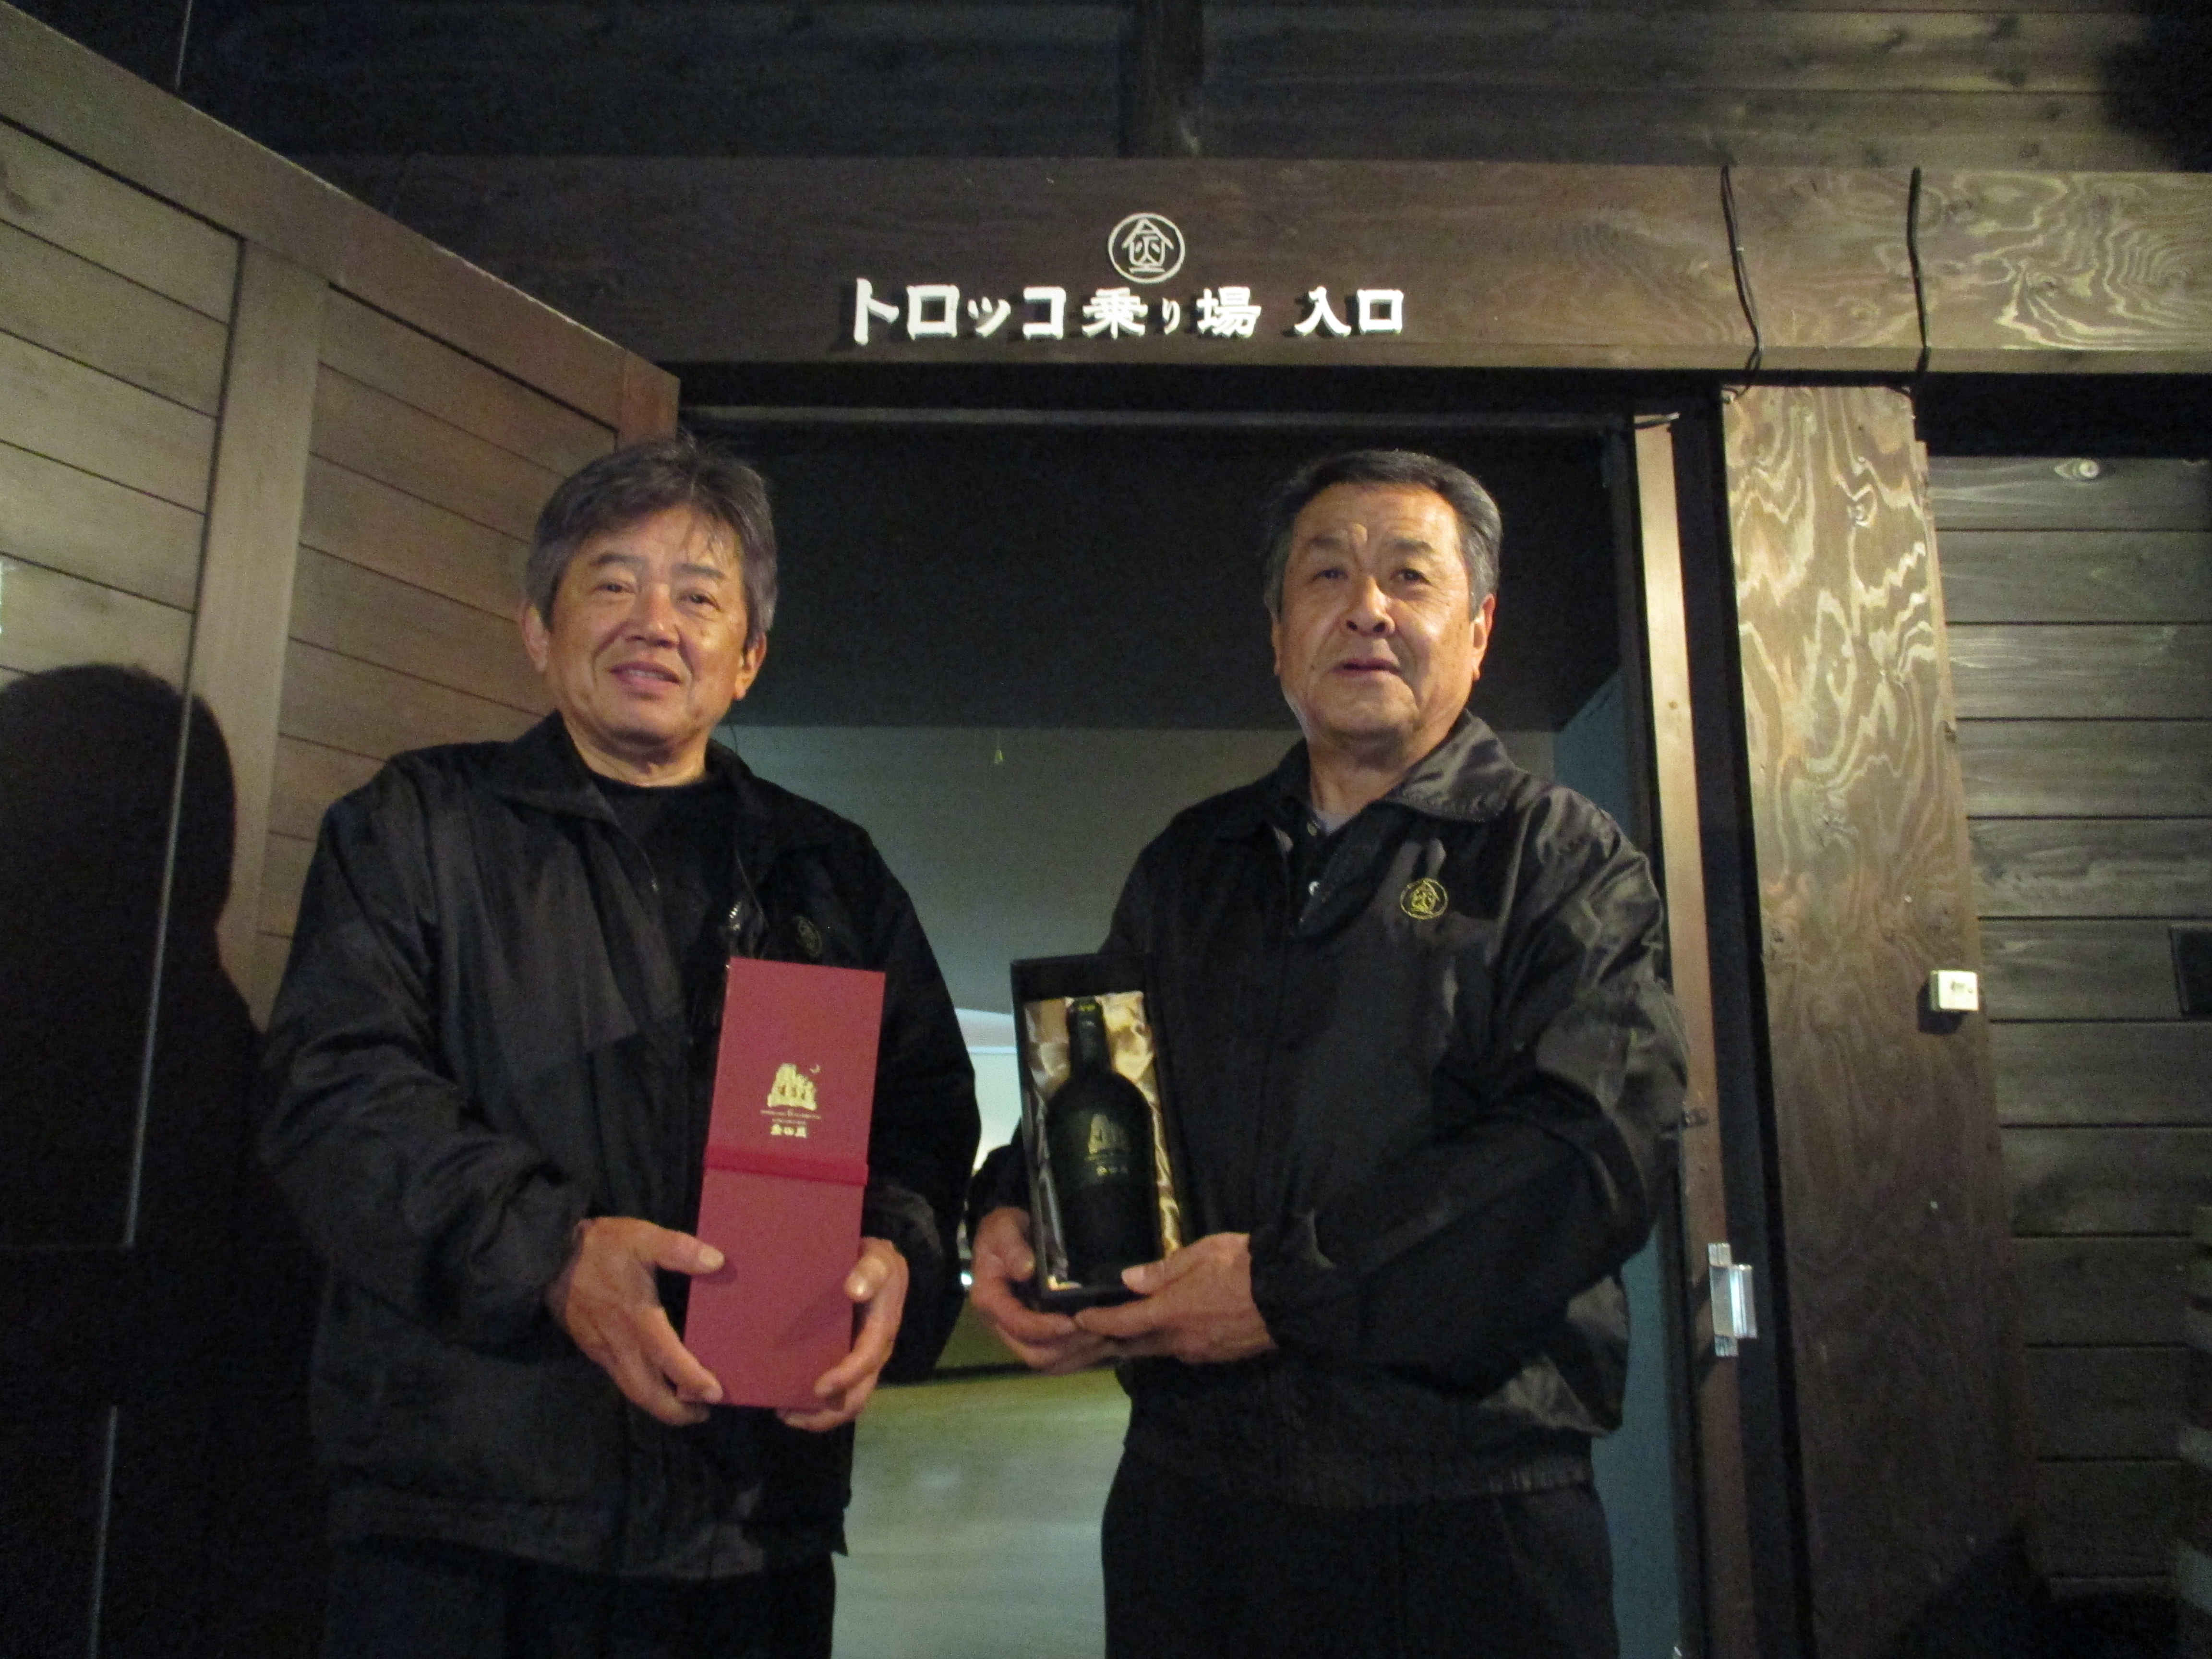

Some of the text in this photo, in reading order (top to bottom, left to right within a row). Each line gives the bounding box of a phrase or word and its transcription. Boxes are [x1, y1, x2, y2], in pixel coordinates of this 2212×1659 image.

[853, 278, 1405, 346] トロッコ乗り場 入口
